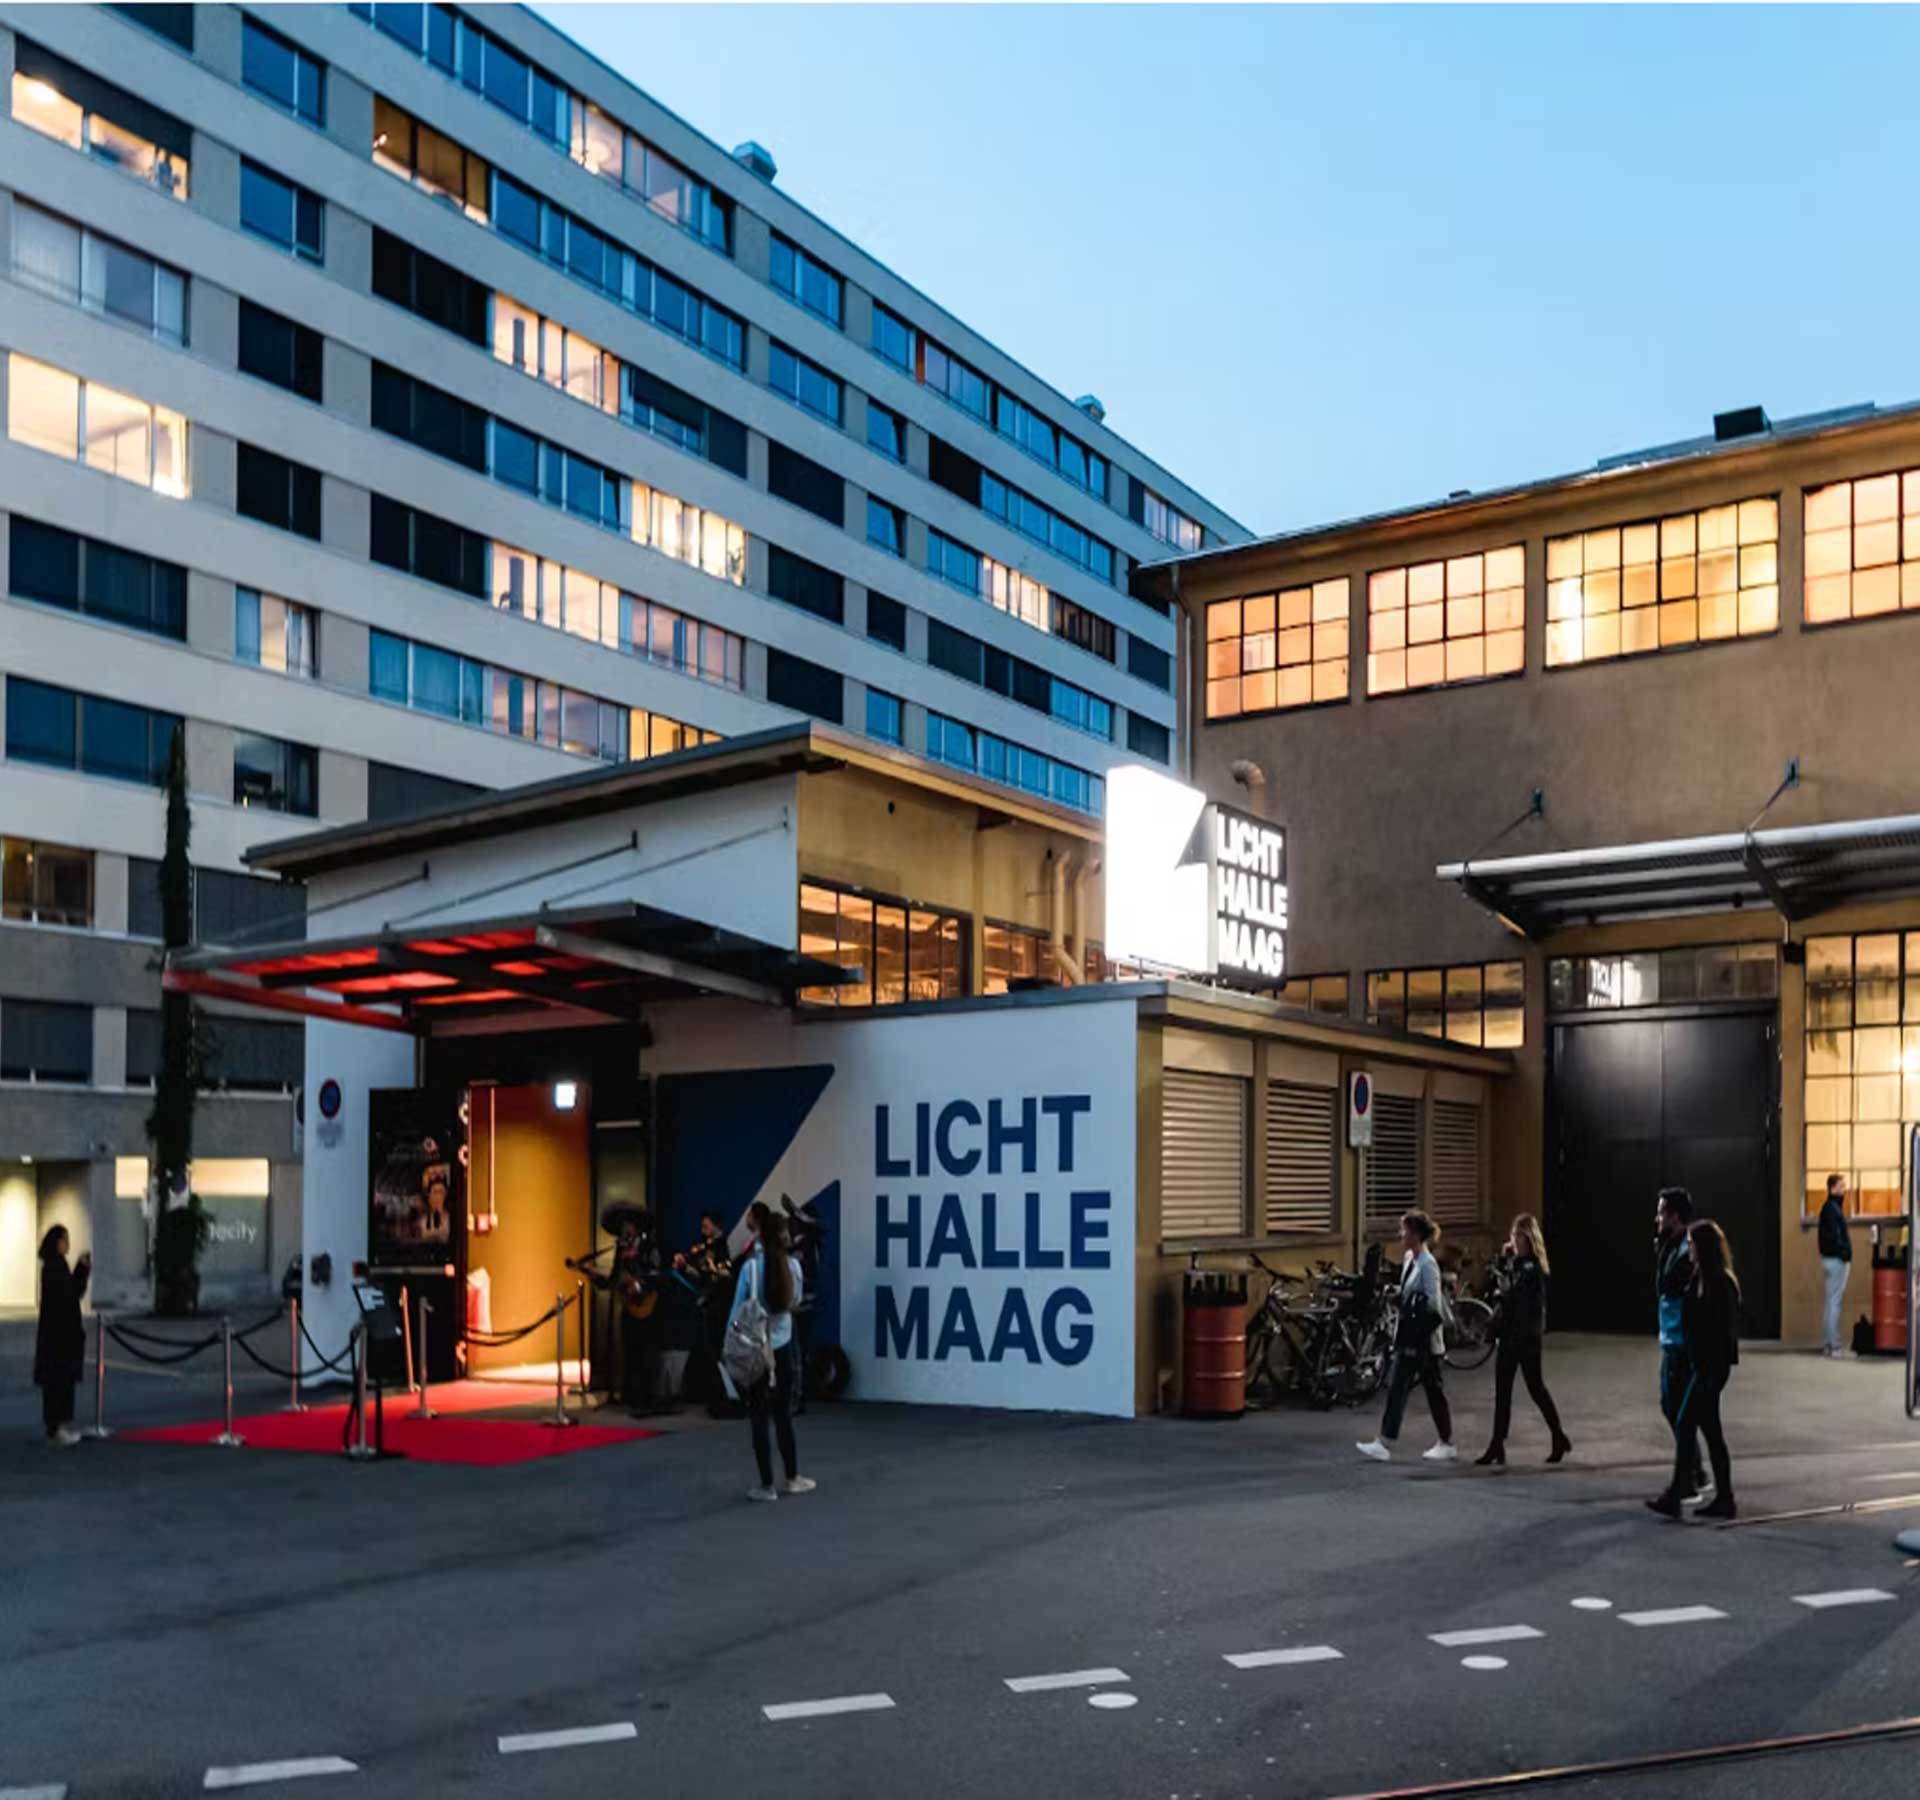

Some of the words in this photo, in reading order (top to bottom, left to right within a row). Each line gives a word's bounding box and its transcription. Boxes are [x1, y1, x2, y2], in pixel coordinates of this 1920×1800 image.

[1217, 812, 1283, 878] LICHT
[1217, 865, 1288, 930] HALLE
[1217, 917, 1284, 977] MAAG
[875, 1095, 1091, 1177] LICHT
[875, 1190, 1111, 1269] HALLE
[875, 1285, 1094, 1367] MAAG
